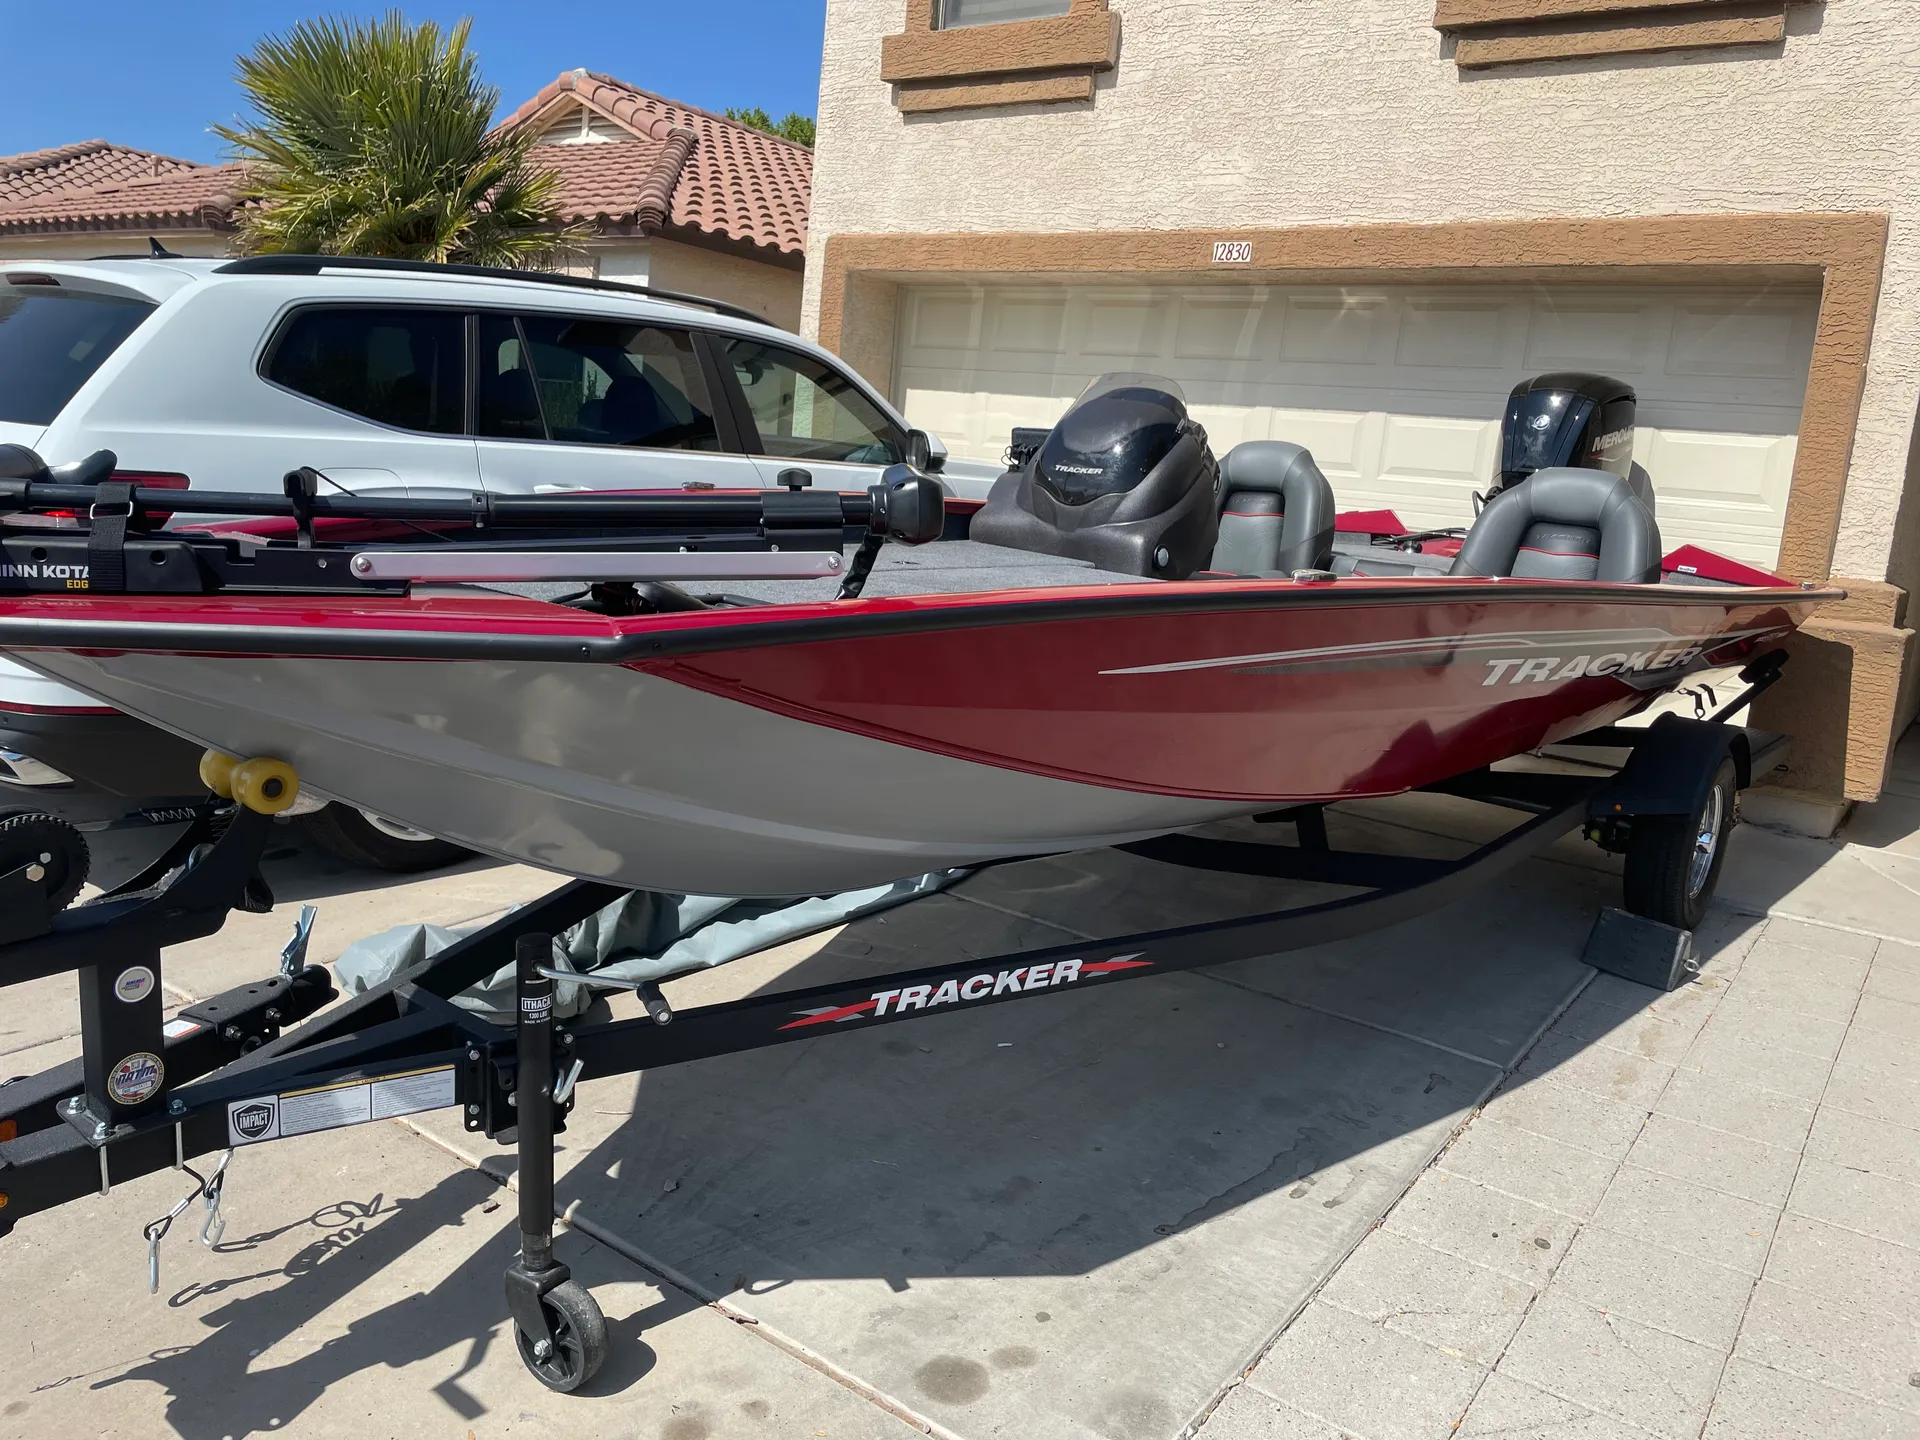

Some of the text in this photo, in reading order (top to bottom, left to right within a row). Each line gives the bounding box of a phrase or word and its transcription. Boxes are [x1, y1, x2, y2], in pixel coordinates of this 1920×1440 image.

[1214, 243, 1250, 261] 12830
[1055, 464, 1103, 475] TRACKER
[0, 564, 38, 578] INN
[1481, 647, 1703, 686] TRACKER
[870, 958, 1083, 1017] TRACKER
[524, 997, 550, 1009] ITHACA
[240, 1112, 269, 1129] IMPACT
